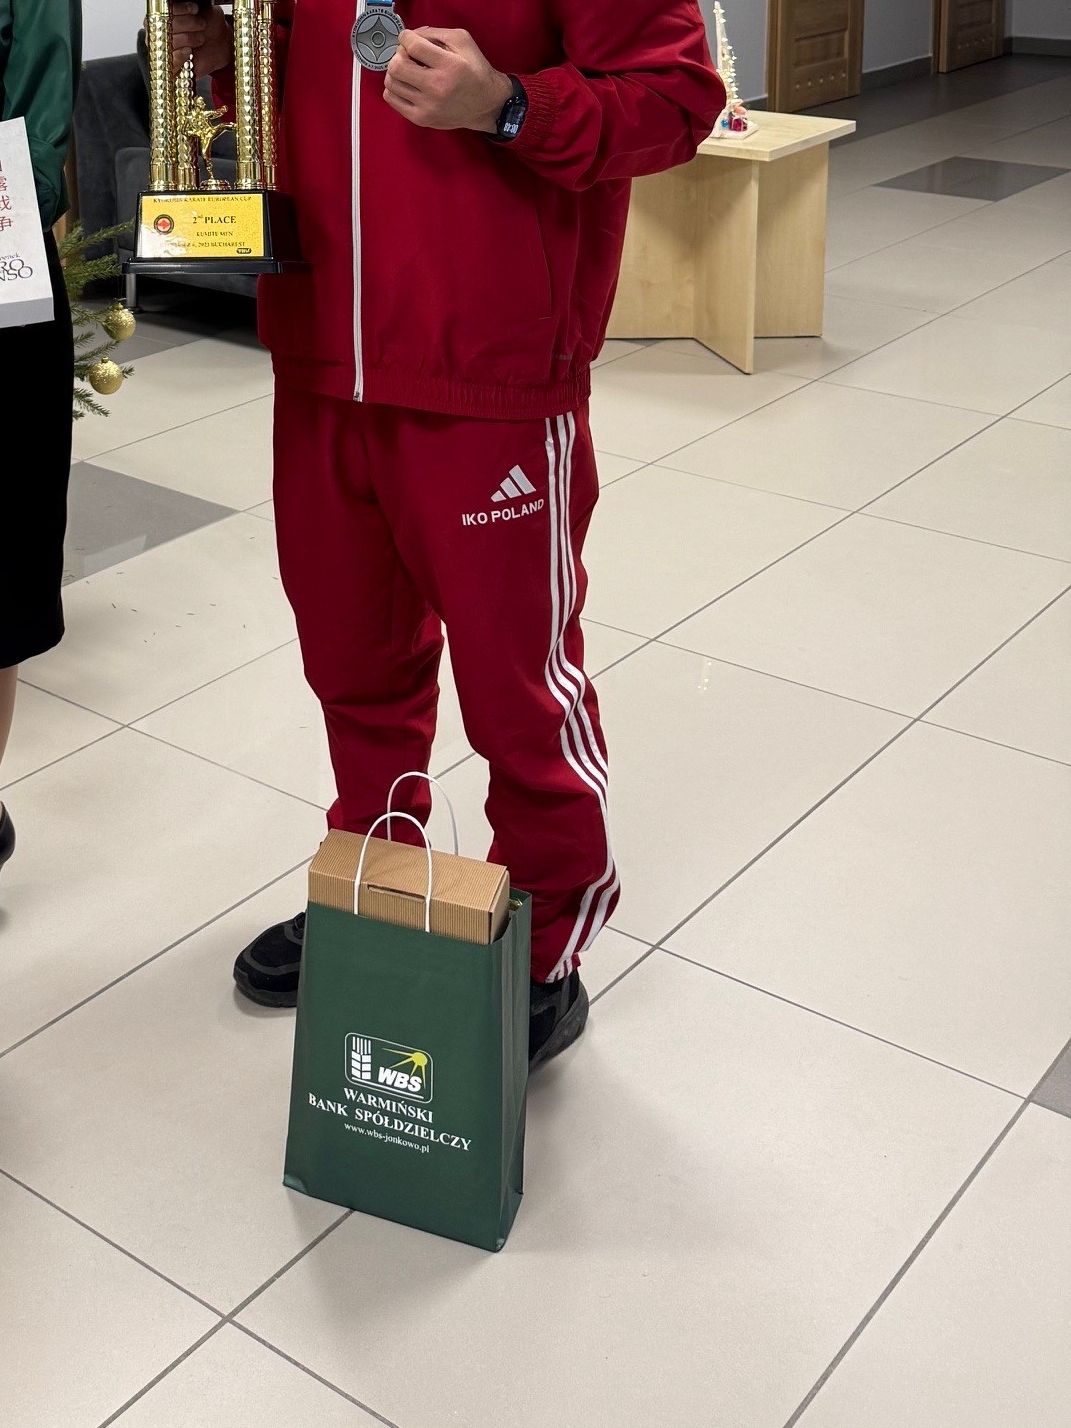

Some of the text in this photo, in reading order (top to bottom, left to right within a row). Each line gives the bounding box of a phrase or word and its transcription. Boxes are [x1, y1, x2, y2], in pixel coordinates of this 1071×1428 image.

[204, 215, 237, 224] PLACE
[461, 499, 544, 526] IKO POLAND
[377, 1066, 423, 1093] WBS
[343, 1088, 434, 1123] WARMIŃSKI
[308, 1092, 472, 1151] BANK SPÓŁDZIELCZY
[343, 1122, 430, 1153] www.wbs-jonkowo.pl
